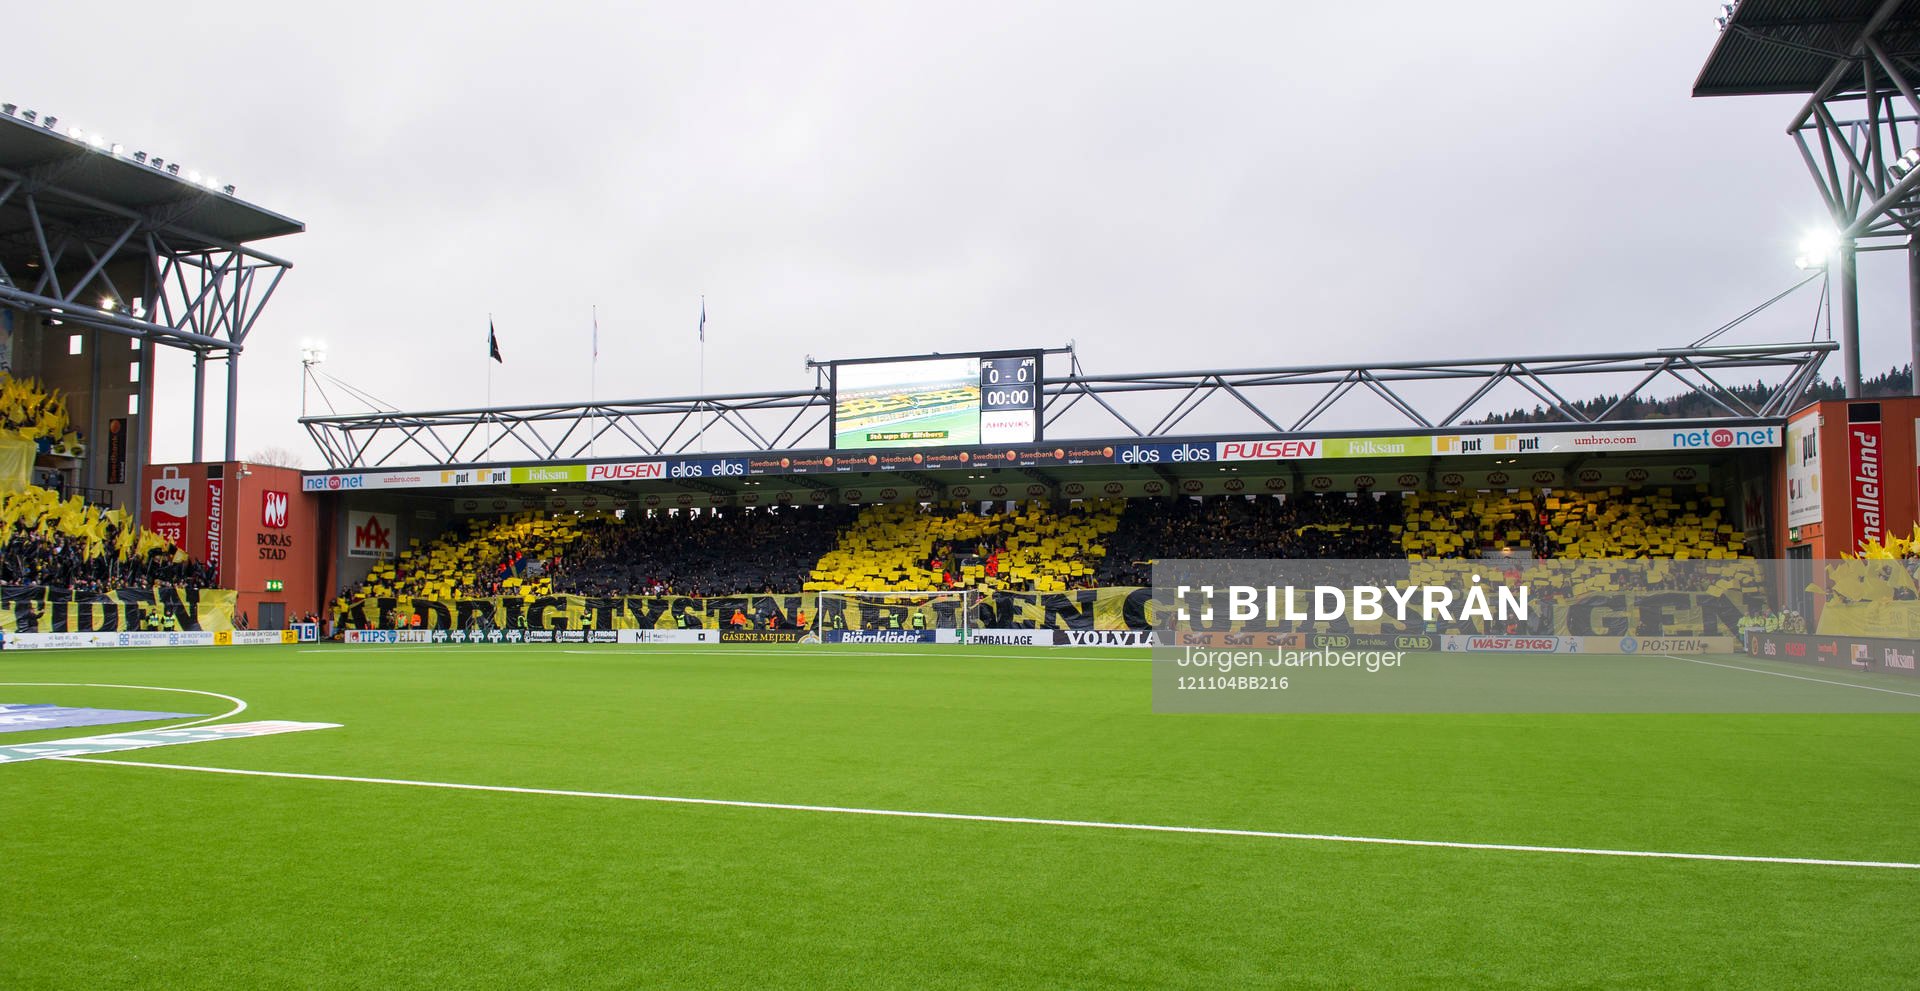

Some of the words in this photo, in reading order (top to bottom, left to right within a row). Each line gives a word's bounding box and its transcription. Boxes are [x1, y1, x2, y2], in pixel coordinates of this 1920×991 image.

[989, 369, 999, 384] 0
[1017, 367, 1027, 382] 0
[987, 389, 1029, 406] 00:00
[1348, 440, 1405, 454] Folksam
[1573, 435, 1636, 445] umbro.com
[1121, 445, 1160, 462] ellos
[1171, 443, 1209, 461] ellos
[1222, 441, 1316, 459] PULSEN
[837, 457, 868, 465] Swedbank
[881, 456, 913, 464] Swedbank
[926, 454, 958, 462] Swedbank
[591, 463, 662, 480] PULSEN
[671, 461, 702, 478] ellos
[711, 459, 744, 476] ellos
[529, 469, 569, 481] Folksam
[154, 486, 186, 505] City
[355, 515, 391, 549] MAX
[257, 533, 292, 548] BORÅS
[258, 549, 288, 561] STAD
[359, 630, 386, 643] TIPS
[399, 631, 427, 643] ELIT
[722, 631, 758, 642] GÄSENE
[760, 632, 796, 643] MEJERI
[841, 631, 922, 644] Björnkläder
[973, 635, 1033, 646] EMBALLAGE
[1065, 631, 1163, 647] VOLVIA
[1317, 636, 1347, 647] EAB
[1398, 637, 1429, 648] EAB
[1472, 637, 1553, 650] WÄST-BYGG
[1641, 639, 1701, 651] POSTEN!
[1763, 639, 1777, 656] ellos
[1884, 647, 1916, 670] Folksam
